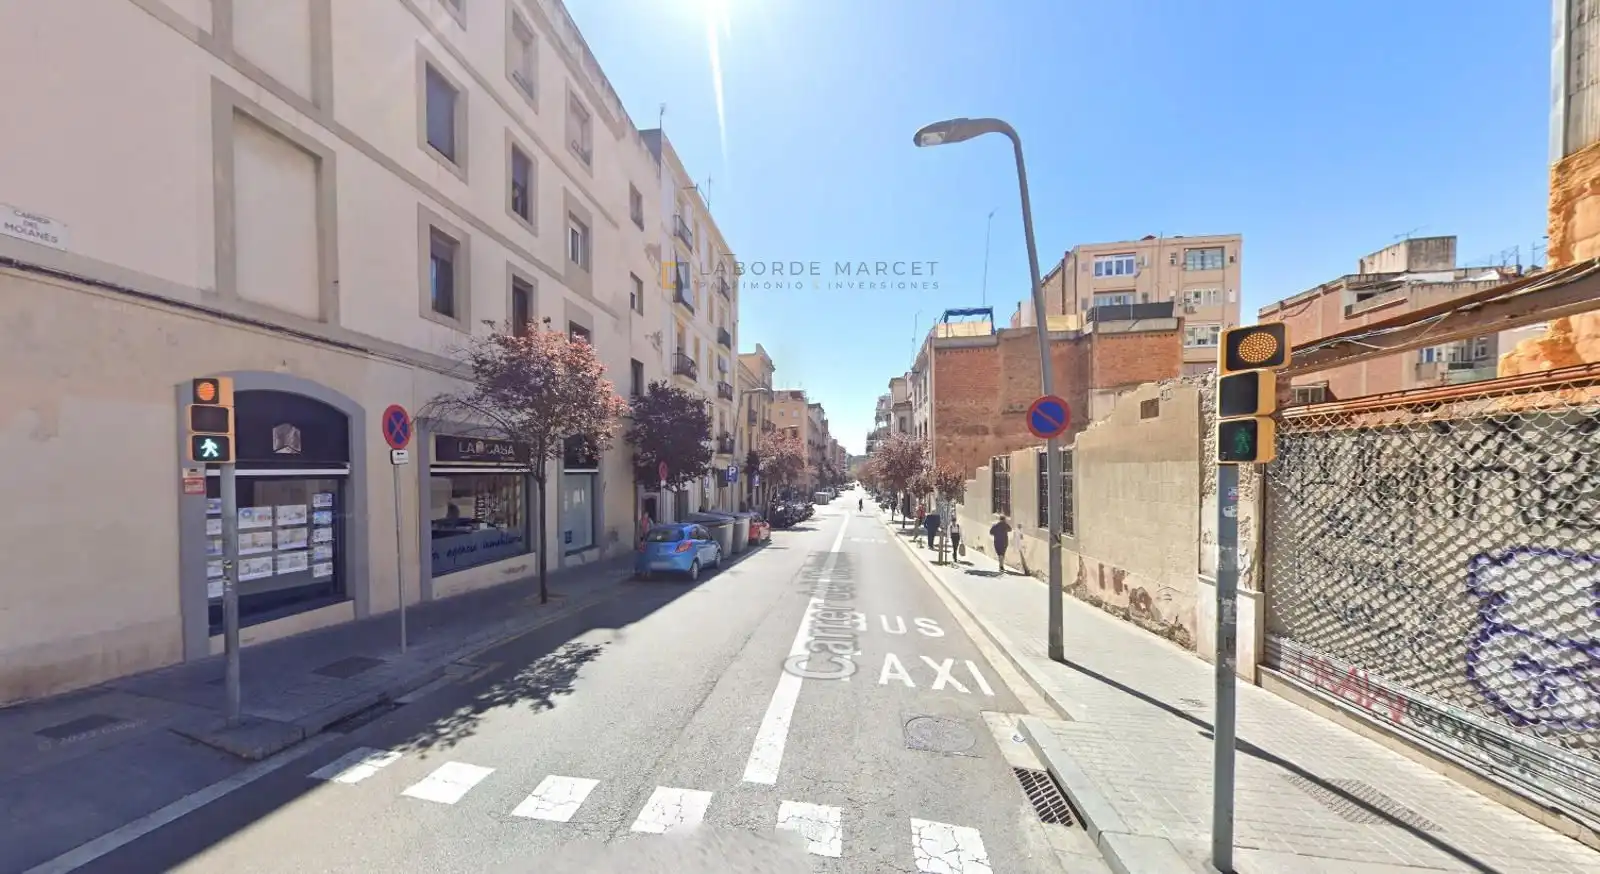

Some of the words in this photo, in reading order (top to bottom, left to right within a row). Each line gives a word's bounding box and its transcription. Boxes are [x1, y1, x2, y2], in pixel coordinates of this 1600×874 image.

[459, 441, 475, 454] LA
[729, 466, 737, 476] P
[834, 650, 995, 696] AXI
